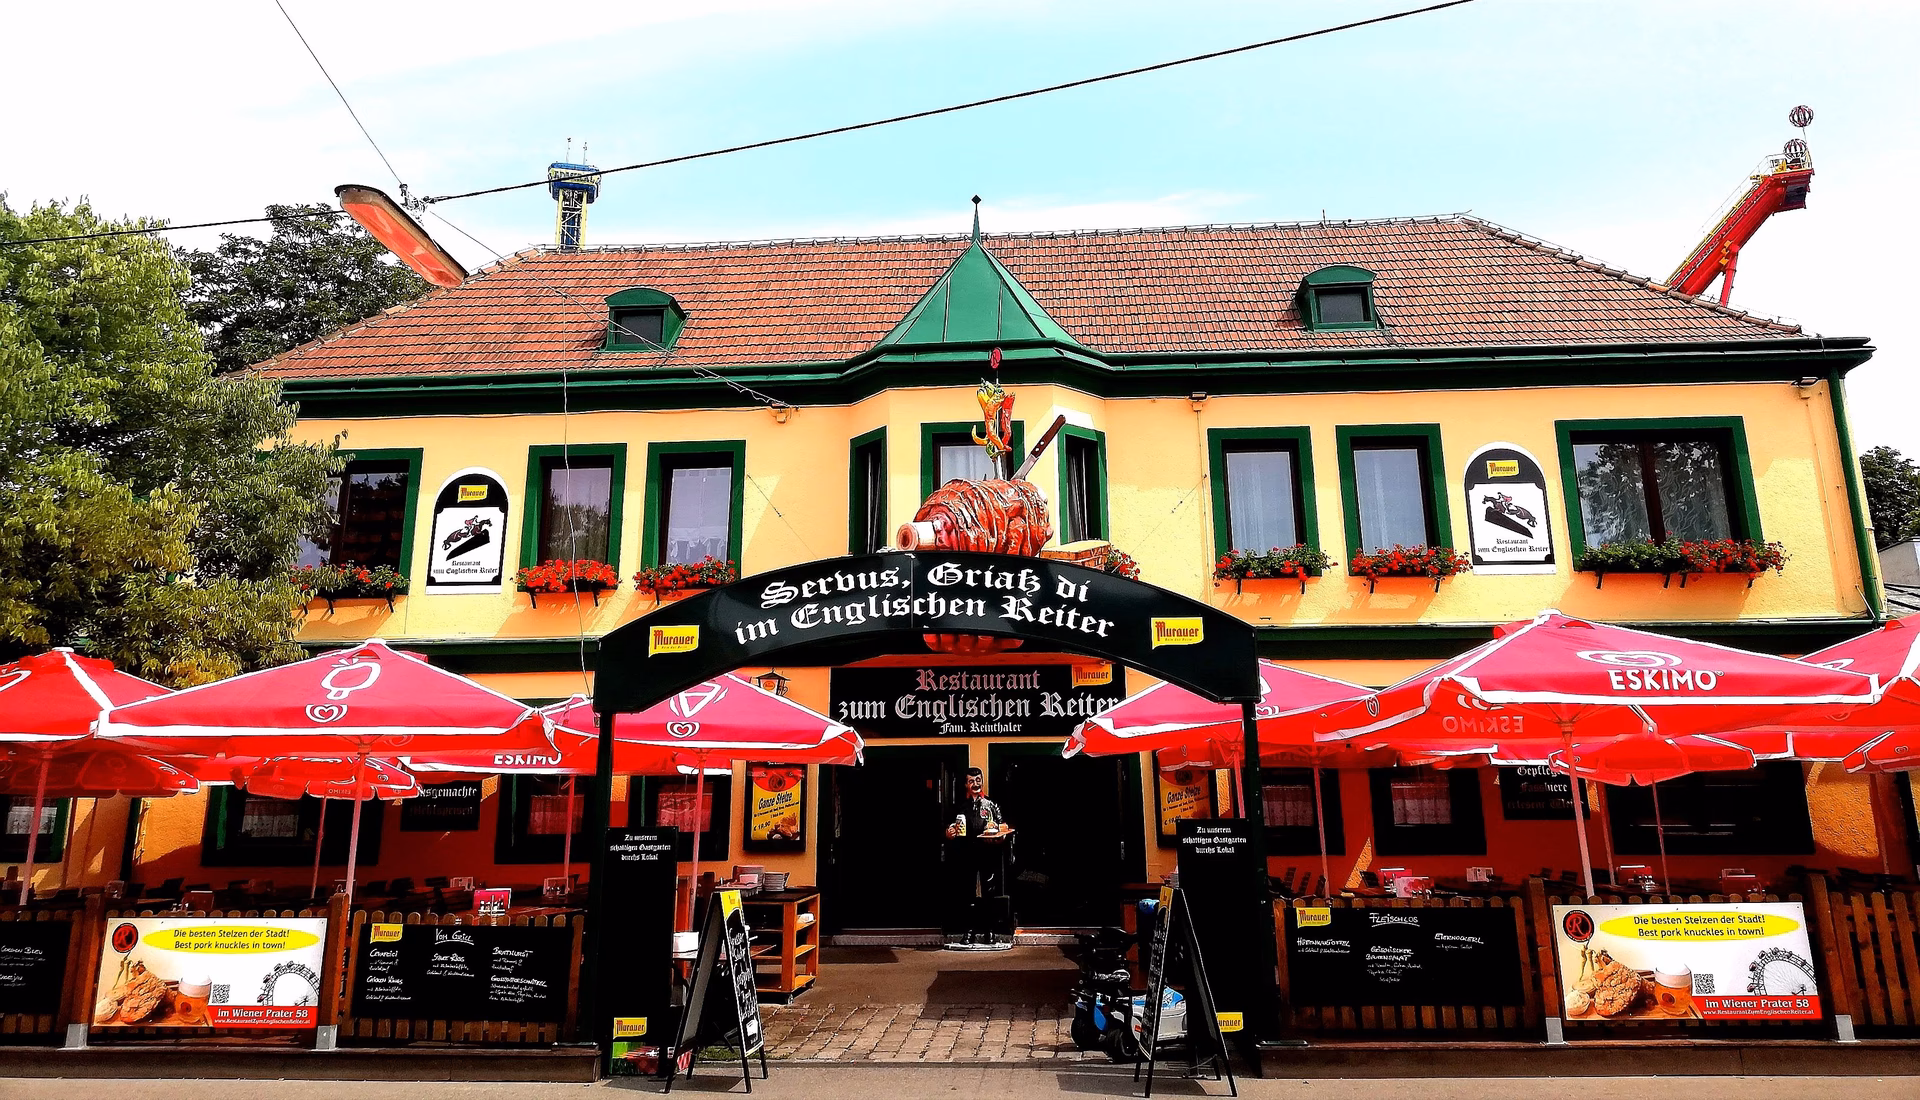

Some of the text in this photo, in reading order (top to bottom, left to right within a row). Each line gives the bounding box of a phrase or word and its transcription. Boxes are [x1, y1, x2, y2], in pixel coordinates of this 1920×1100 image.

[1491, 545, 1527, 554] Englischen
[445, 567, 478, 575] Englischen
[760, 566, 912, 609] Servus,
[1056, 574, 1092, 603] di
[735, 591, 1115, 645] im Englischen Reiter
[1155, 621, 1200, 642] Murauer
[653, 629, 695, 650] Murauer
[915, 669, 1041, 691] Restaurant
[1074, 665, 1110, 682] Murauer
[1606, 668, 1719, 692] ESKIMO
[838, 700, 887, 723] zum
[894, 693, 1032, 723] Englischen
[938, 722, 1023, 735] Fam. Reinthaler
[493, 752, 562, 766] ESKIMO
[1196, 826, 1206, 834] Zu
[1298, 909, 1329, 924] Murauer
[1633, 915, 1766, 925] Die besten Stelzen der Stadt!
[173, 929, 290, 938] Die besten Stelzen der Stadt!
[374, 925, 400, 940] Murauer
[1638, 926, 1765, 938] Best pork knuckles in town!
[174, 940, 286, 951] Best pork knuckles in town!
[1705, 998, 1810, 1008] im Wiener Prater 58
[217, 1008, 309, 1018] im Wiener Prater 58
[616, 1020, 645, 1035] Murauer
